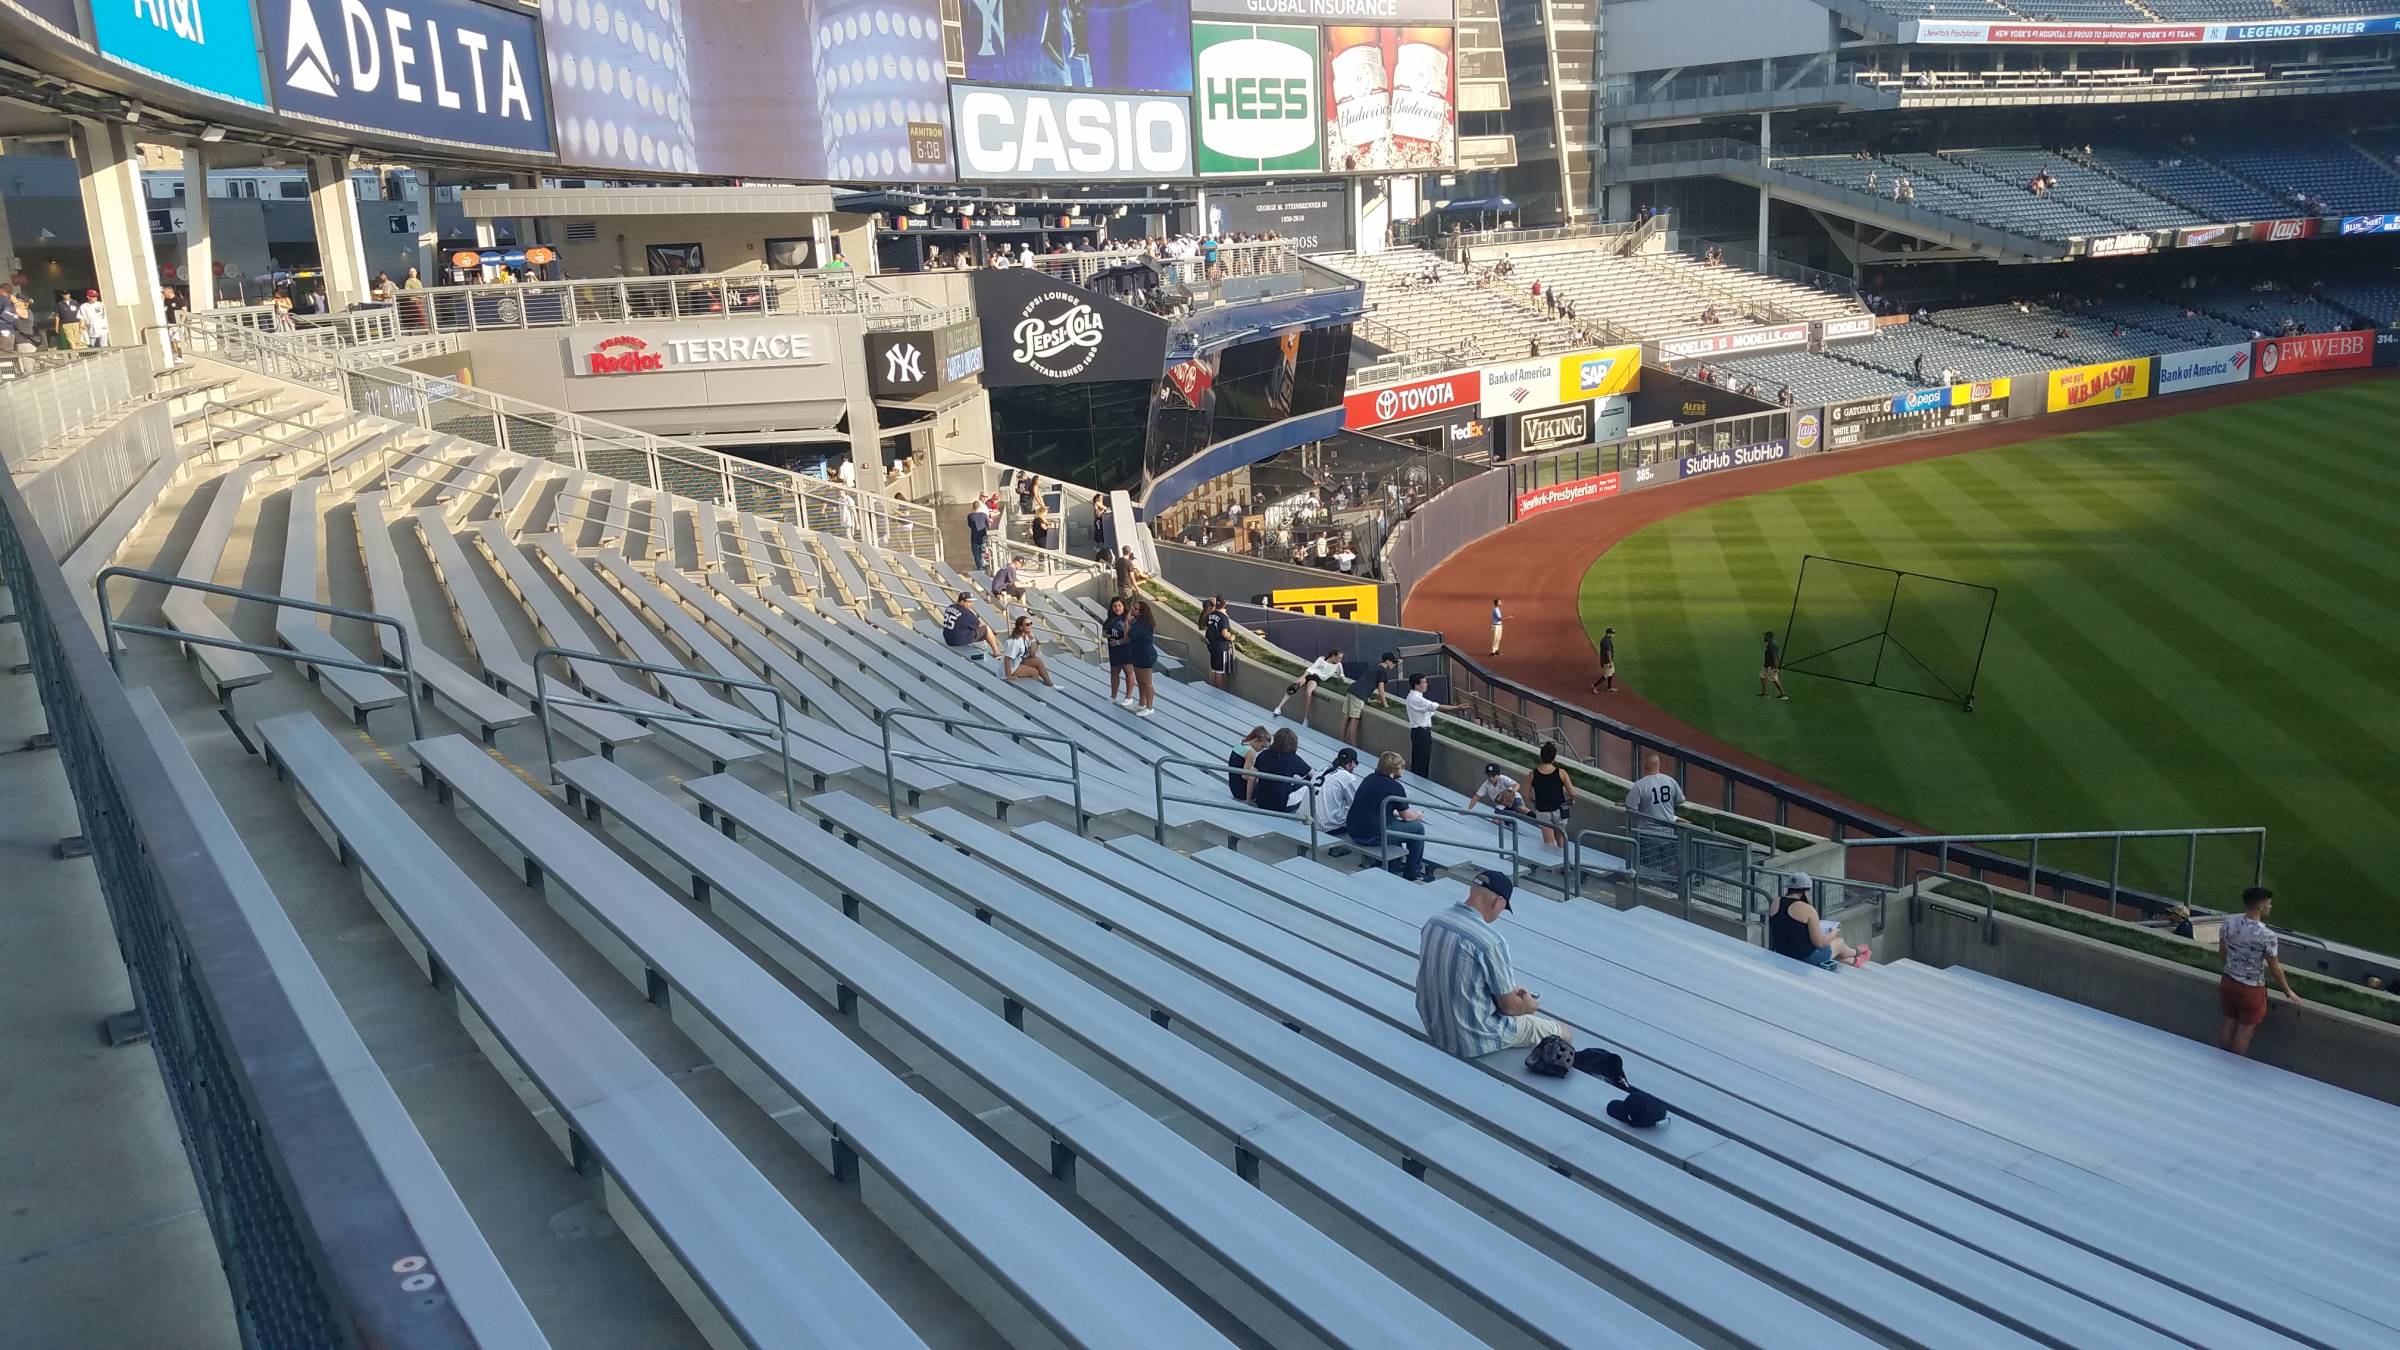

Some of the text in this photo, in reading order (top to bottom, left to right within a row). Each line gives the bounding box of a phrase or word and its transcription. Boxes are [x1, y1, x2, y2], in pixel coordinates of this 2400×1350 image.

[1247, 0, 1398, 16] GLOBAL INSURANCE
[2039, 30, 2066, 38] HOSPITAL
[2102, 31, 2127, 39] SUPPORT
[2128, 31, 2141, 39] NEW
[2239, 23, 2366, 38] LEGENDS PREMIER
[341, 0, 533, 121] DELTA
[1207, 77, 1308, 120] HESS
[909, 126, 942, 138] ARMITRON
[962, 92, 1187, 173] CASIO
[916, 141, 940, 159] 6:08
[1022, 291, 1080, 318] PEPSI LOUNGE
[1827, 320, 1869, 335] MODELL'S
[668, 333, 812, 364] TERRACE
[1664, 338, 1713, 355] MODELL'S
[1732, 330, 1804, 347] MODELLS.com
[2312, 336, 2364, 357] WEBB
[2377, 334, 2393, 344] 314
[1029, 360, 1084, 378] ESTABLISHED
[1488, 365, 1551, 386] Bank of America
[1580, 365, 1609, 387] SAP
[2160, 361, 2227, 384] Bank of America
[1399, 382, 1455, 412] TOYOTA
[1917, 390, 1941, 406] pepsi
[1843, 403, 1881, 417] GATORADE
[1451, 421, 1483, 441] FedEx
[1524, 415, 1583, 442] VIKING
[1832, 426, 1849, 436] WHITE
[1686, 445, 1784, 475] StubHub StubHub
[1651, 785, 1671, 805] 18
